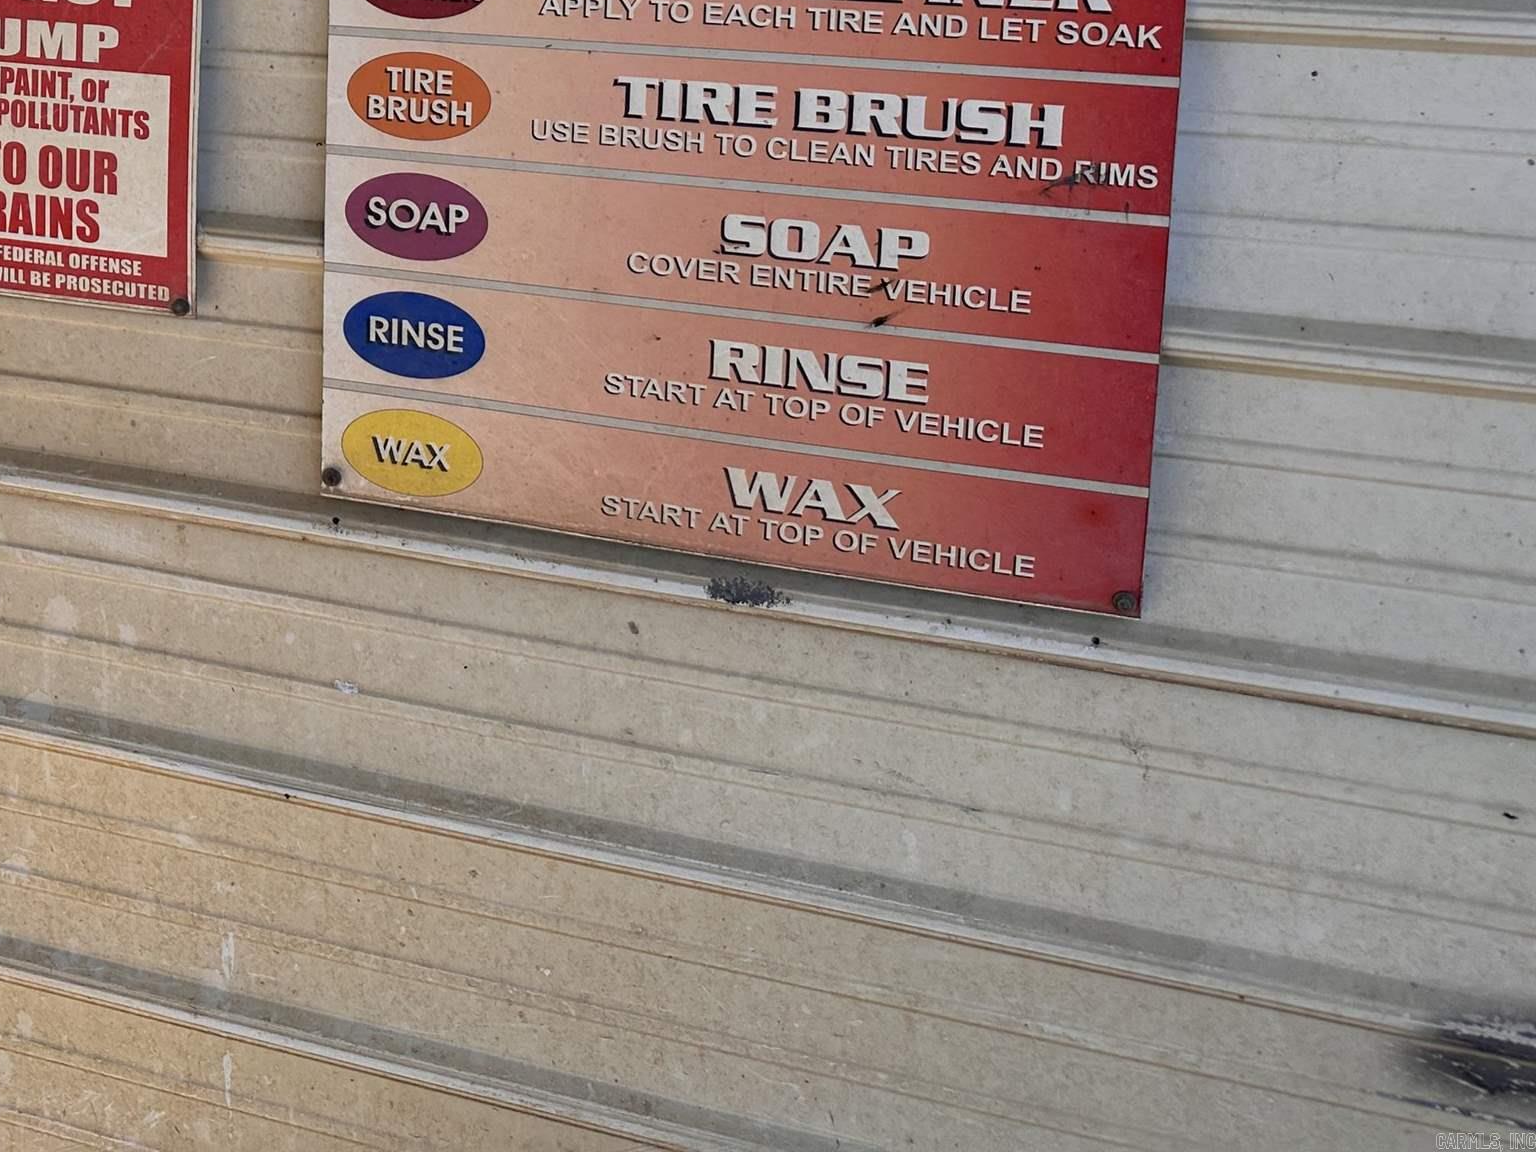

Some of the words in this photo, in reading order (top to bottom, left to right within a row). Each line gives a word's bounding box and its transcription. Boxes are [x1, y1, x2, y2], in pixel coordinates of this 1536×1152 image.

[648, 0, 695, 24] TO
[702, 2, 797, 31] EACH
[806, 8, 885, 34] TIRE
[892, 11, 970, 38] AND
[978, 16, 1048, 44] LET
[1055, 20, 1164, 49] SOAK
[0, 66, 75, 104] PAINT,
[81, 78, 110, 103] or
[386, 65, 454, 96] TIRE
[367, 95, 473, 127] BRUSH
[613, 75, 779, 128] TIRE
[795, 87, 1065, 148] BRUSH
[37, 144, 119, 196] OUR
[531, 119, 590, 144] USE
[598, 124, 706, 153] BRUSH
[713, 132, 757, 157] TO
[765, 135, 876, 168] CLEAN
[884, 144, 983, 176] TIRES
[988, 154, 1063, 182] AND
[1075, 159, 1159, 189] RIMS
[366, 195, 470, 235] SOAP
[68, 251, 142, 277] OFFENSE
[720, 213, 930, 270] SOAP
[30, 269, 51, 288] BE
[55, 273, 170, 302] PROSECUTED
[627, 251, 741, 285] COVER
[750, 263, 872, 297] ENTIRE
[879, 277, 1033, 315] VEHICLE
[369, 314, 464, 353] RINSE
[709, 338, 930, 405] RINSE
[603, 372, 708, 408] START
[712, 386, 754, 412] AT
[764, 393, 831, 424] TOP
[840, 403, 886, 429] OF
[894, 410, 1045, 449] VEHICLE
[372, 432, 451, 473] WAX
[724, 466, 904, 530] WAX
